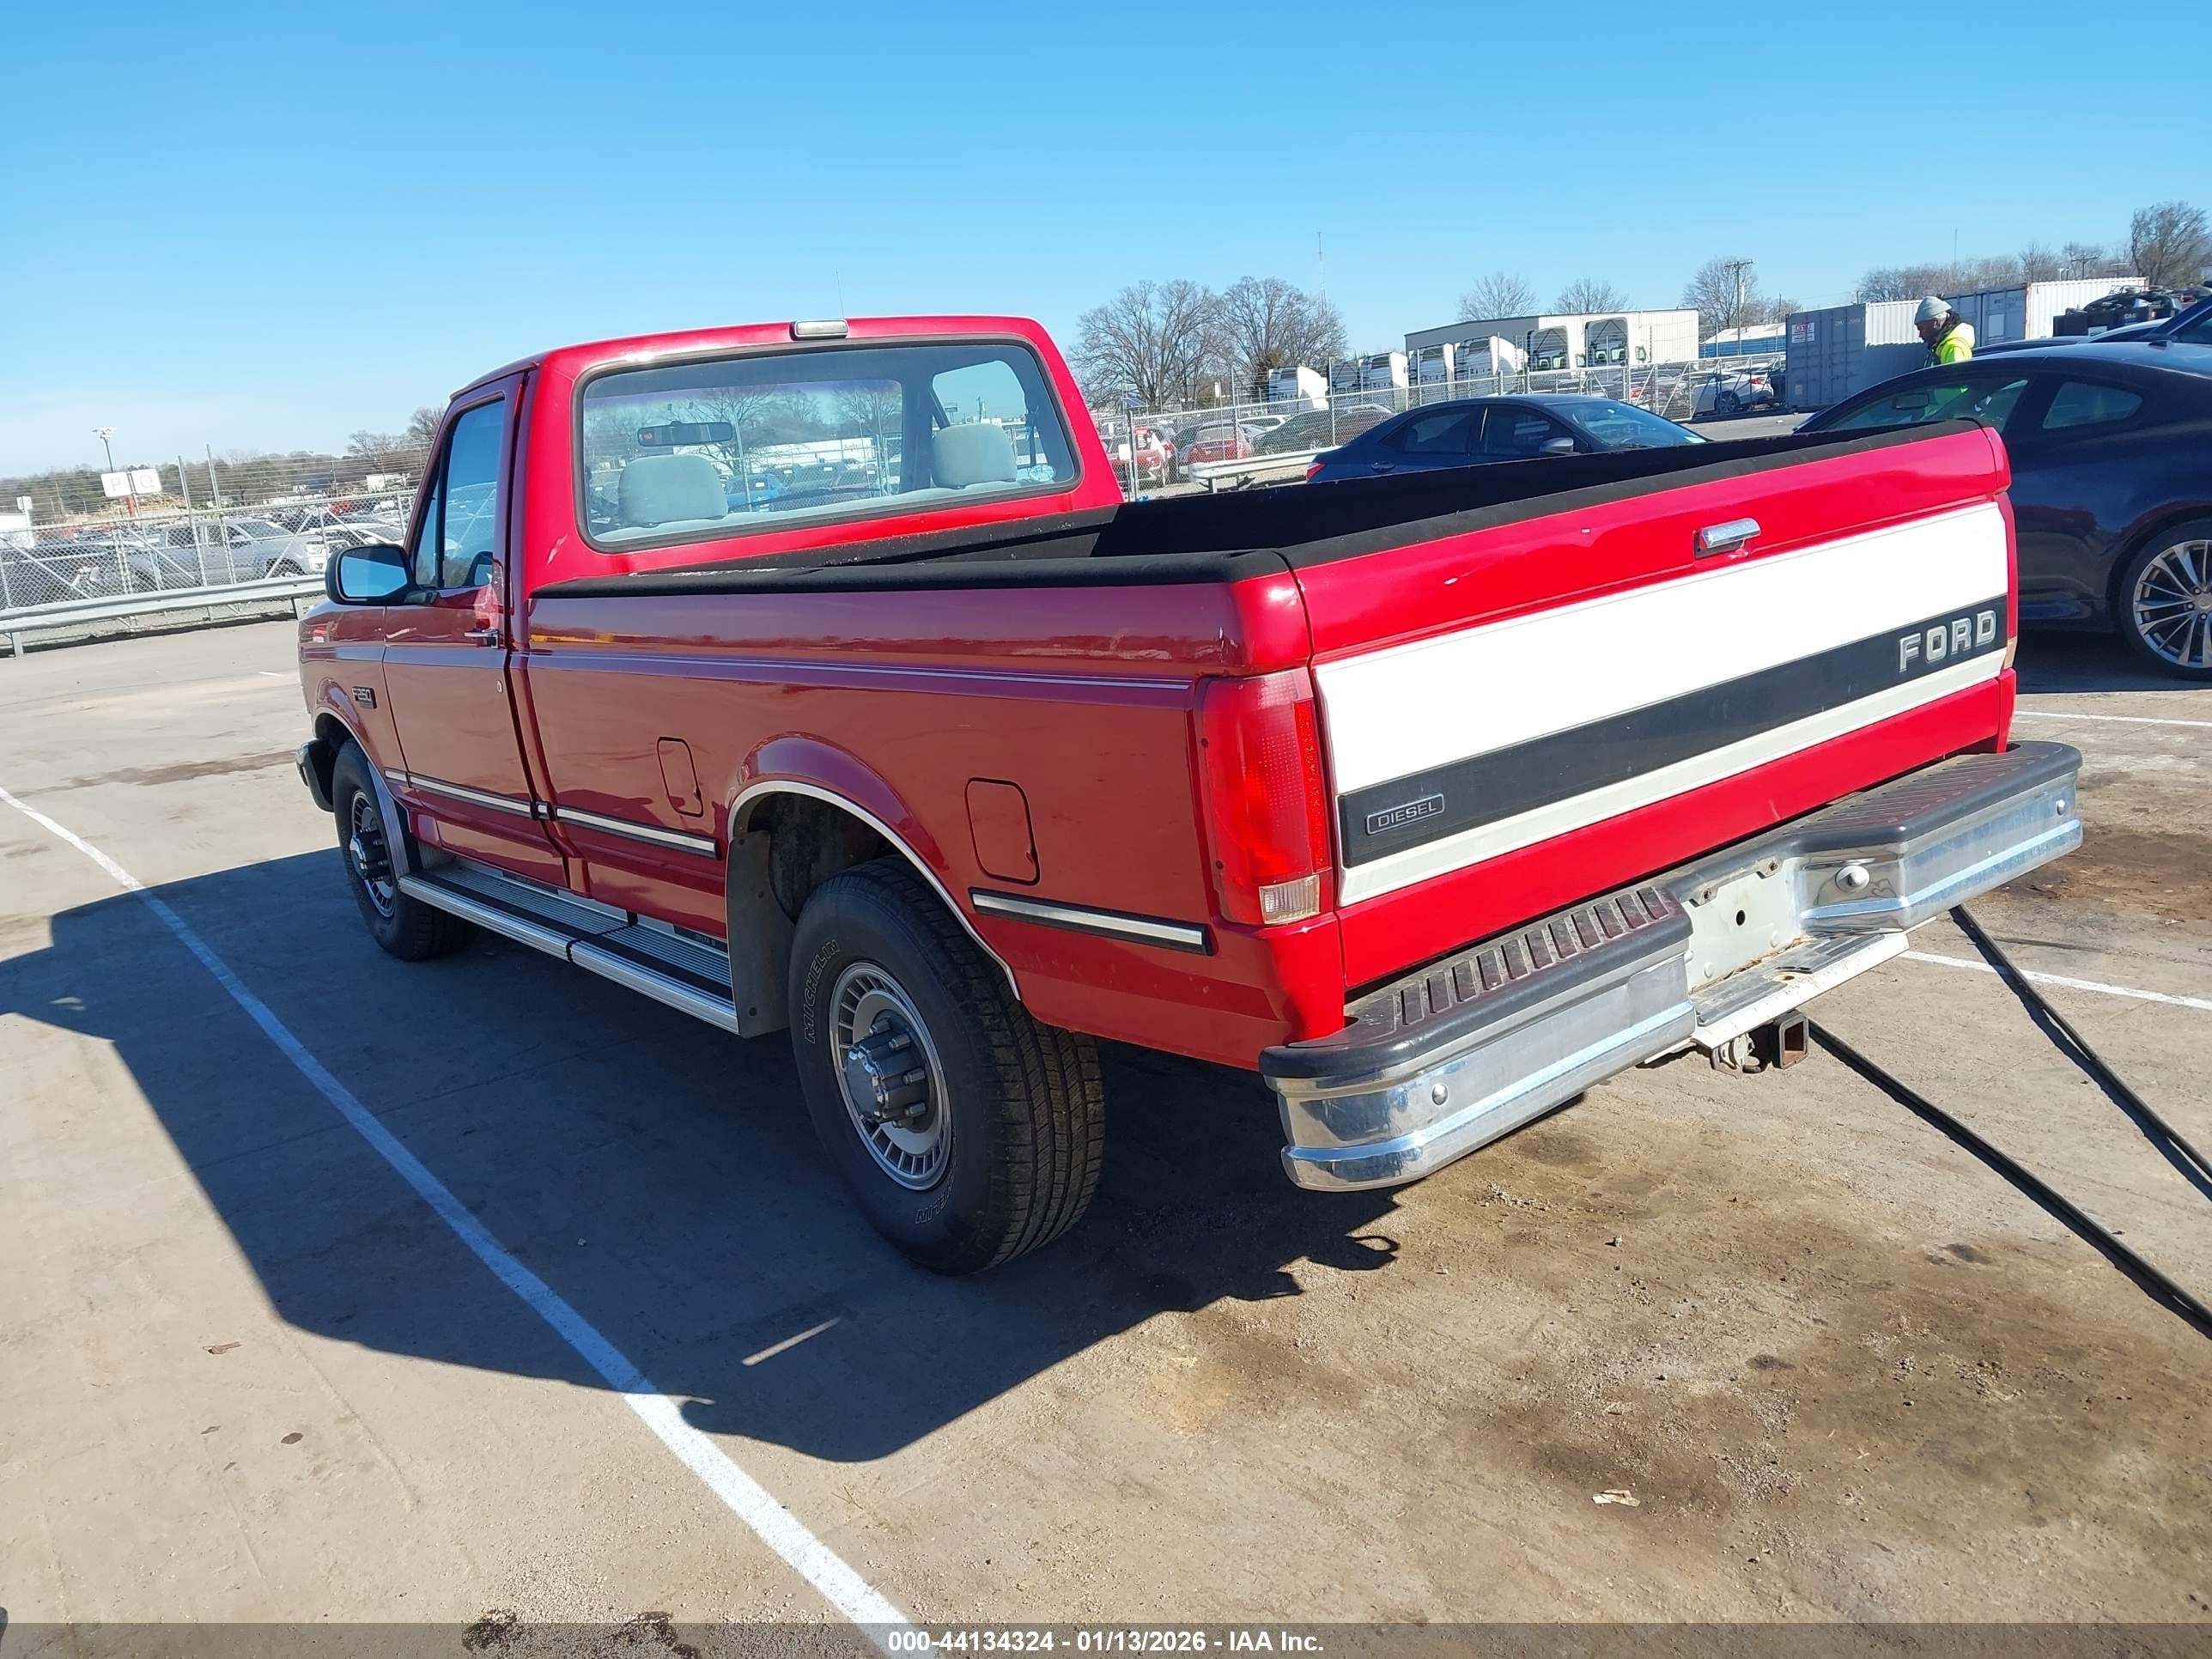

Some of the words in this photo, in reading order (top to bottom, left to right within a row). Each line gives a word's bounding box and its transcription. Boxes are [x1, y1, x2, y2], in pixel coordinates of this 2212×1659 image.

[110, 477, 122, 492] P
[1899, 610, 1997, 673] FORD
[352, 688, 373, 702] F250
[1377, 801, 1437, 828] DIESEL
[803, 939, 841, 1044] MICHELIN
